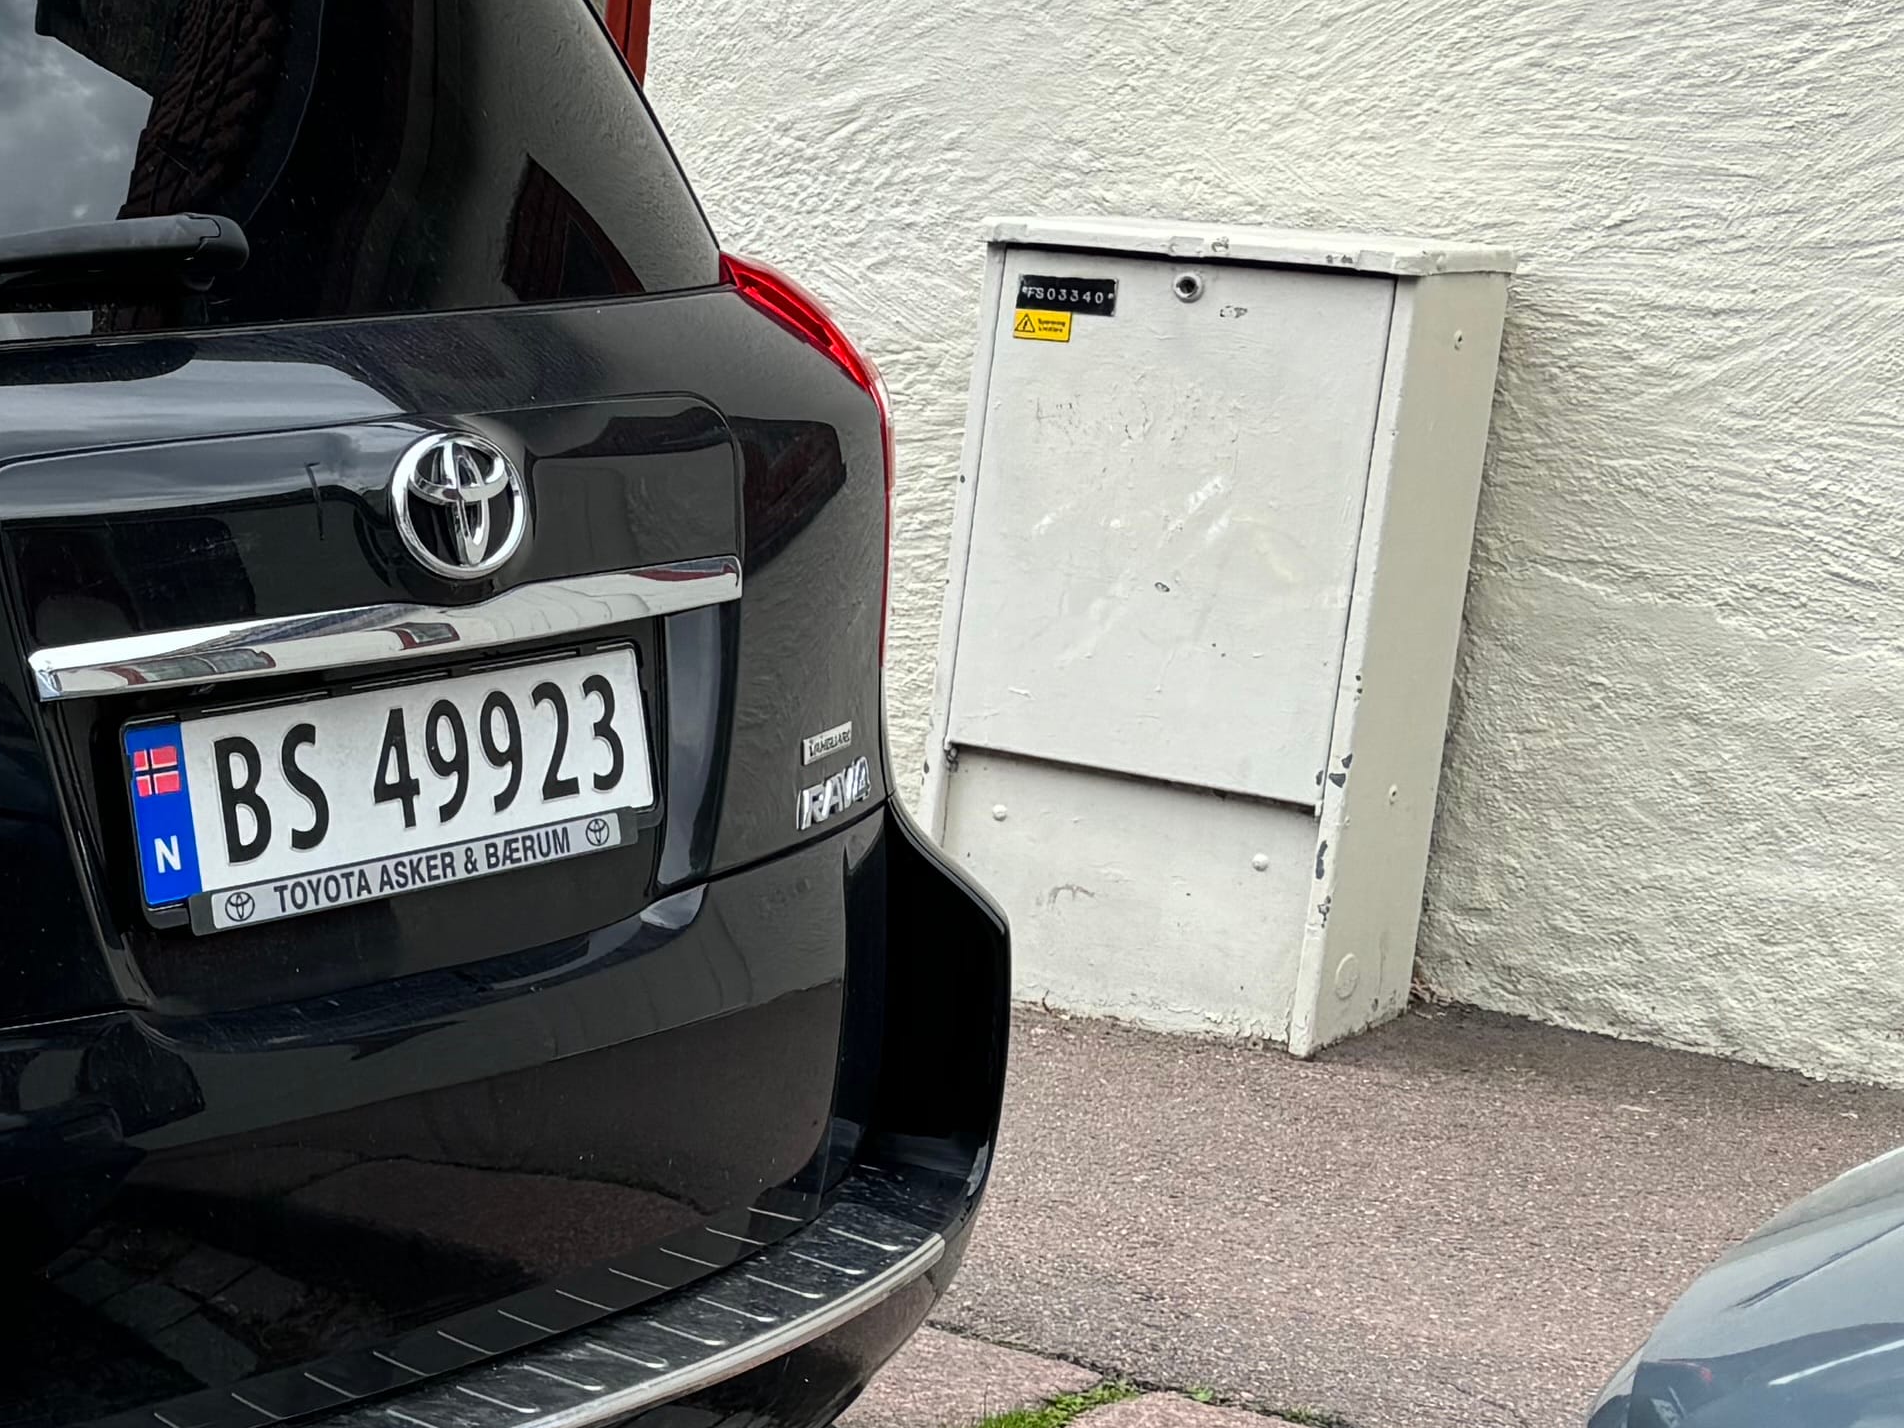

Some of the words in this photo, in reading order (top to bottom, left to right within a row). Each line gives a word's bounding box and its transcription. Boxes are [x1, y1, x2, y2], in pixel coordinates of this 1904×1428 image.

[1026, 286, 1105, 304] FS03340
[213, 722, 331, 865] BS
[372, 673, 626, 831] 49923
[795, 756, 872, 831] RAV4
[153, 834, 183, 874] N
[273, 867, 373, 915] TOYOTA
[379, 849, 457, 895] ASKER
[463, 842, 479, 875] &
[486, 825, 572, 869] BÆRUM
